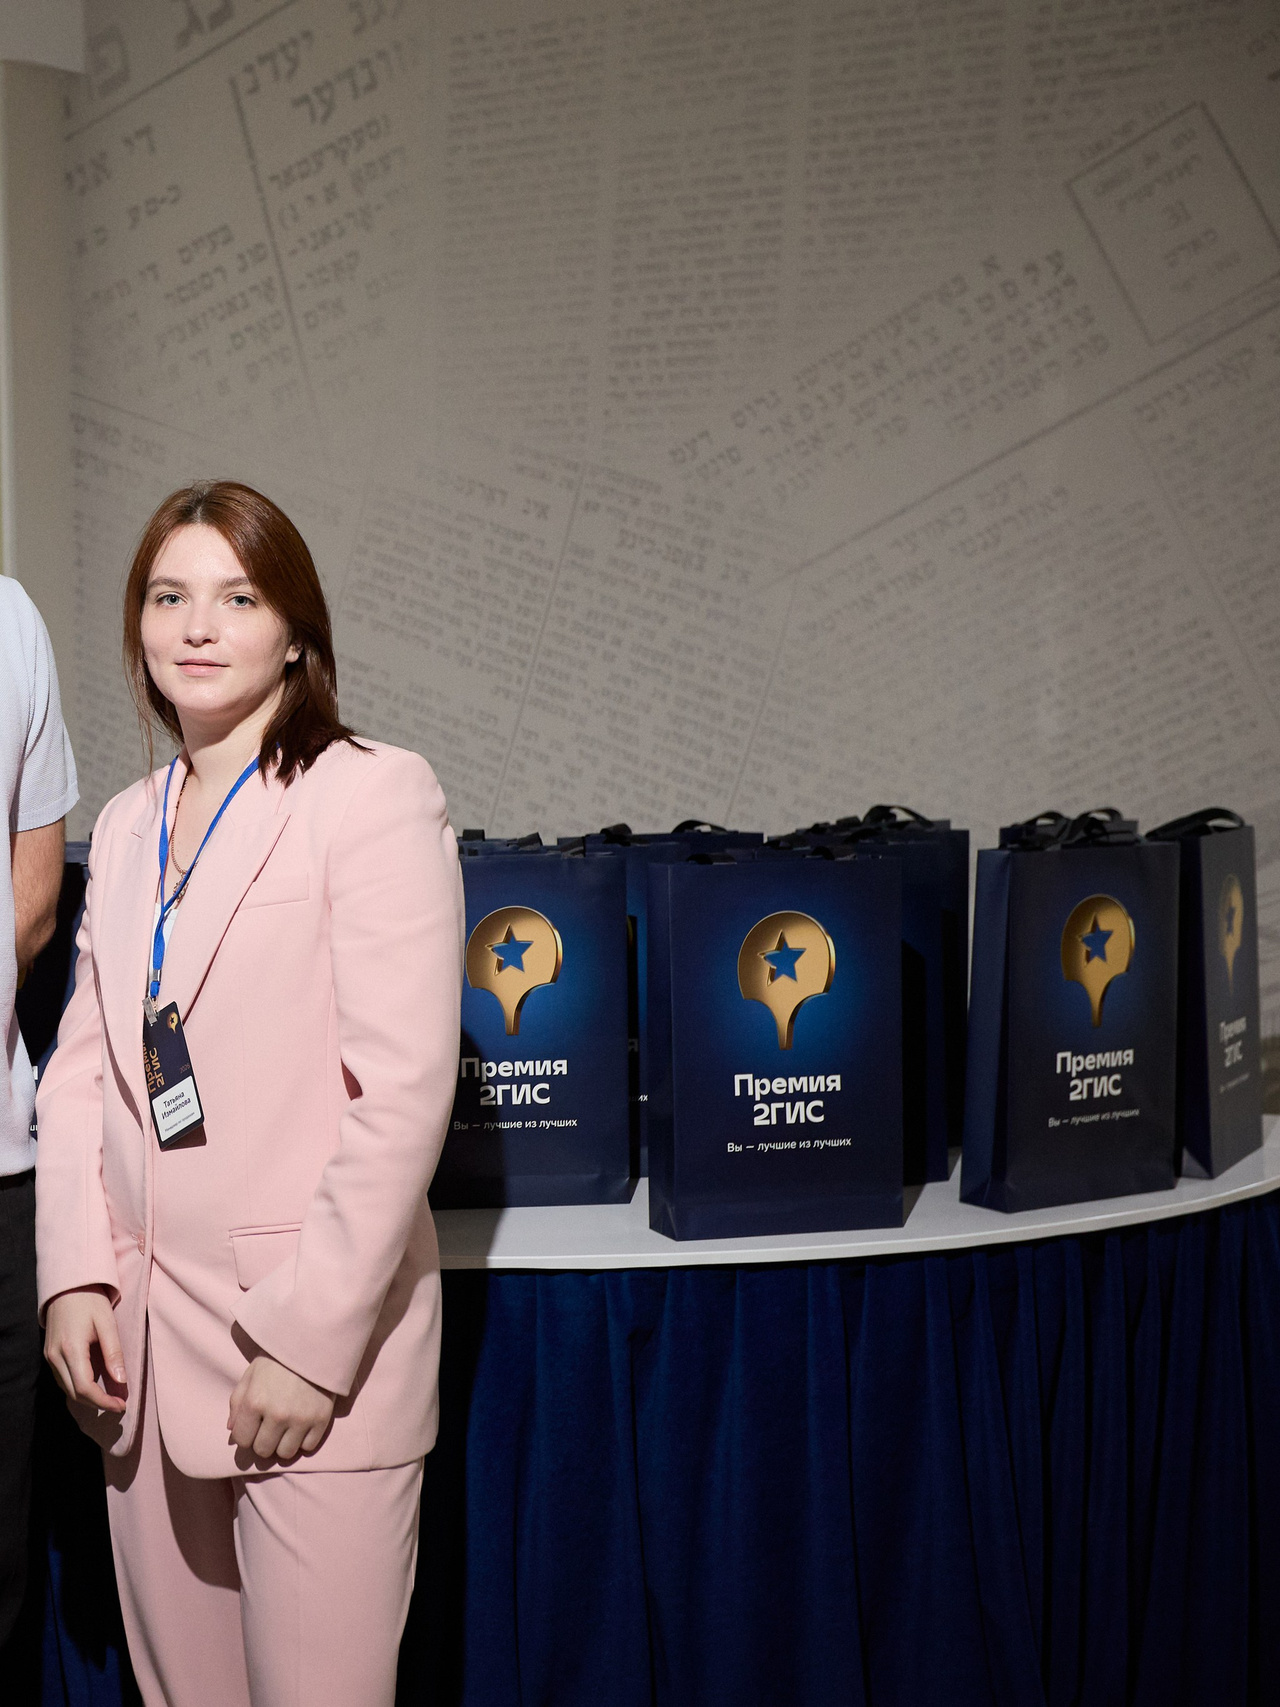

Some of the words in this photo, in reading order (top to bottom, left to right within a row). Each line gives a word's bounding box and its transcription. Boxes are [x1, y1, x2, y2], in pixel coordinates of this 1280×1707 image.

[149, 1047, 165, 1088] 2ГИС
[461, 1057, 568, 1083] Премия
[1056, 1048, 1134, 1078] Премия
[163, 1091, 185, 1108] Татьяна
[480, 1083, 551, 1106] 2ГИС
[734, 1073, 841, 1101] Премия
[1069, 1073, 1122, 1101] 2ГИС
[161, 1097, 191, 1120] Измайлова
[753, 1100, 825, 1126] 2ГИС
[453, 1121, 469, 1131] Вы
[483, 1121, 523, 1131] лучшие
[525, 1120, 537, 1128] из
[539, 1118, 578, 1130] лучших
[727, 1142, 743, 1153] Вы
[757, 1141, 797, 1153] лучшие
[799, 1140, 811, 1149] из
[813, 1138, 851, 1150] лучших
